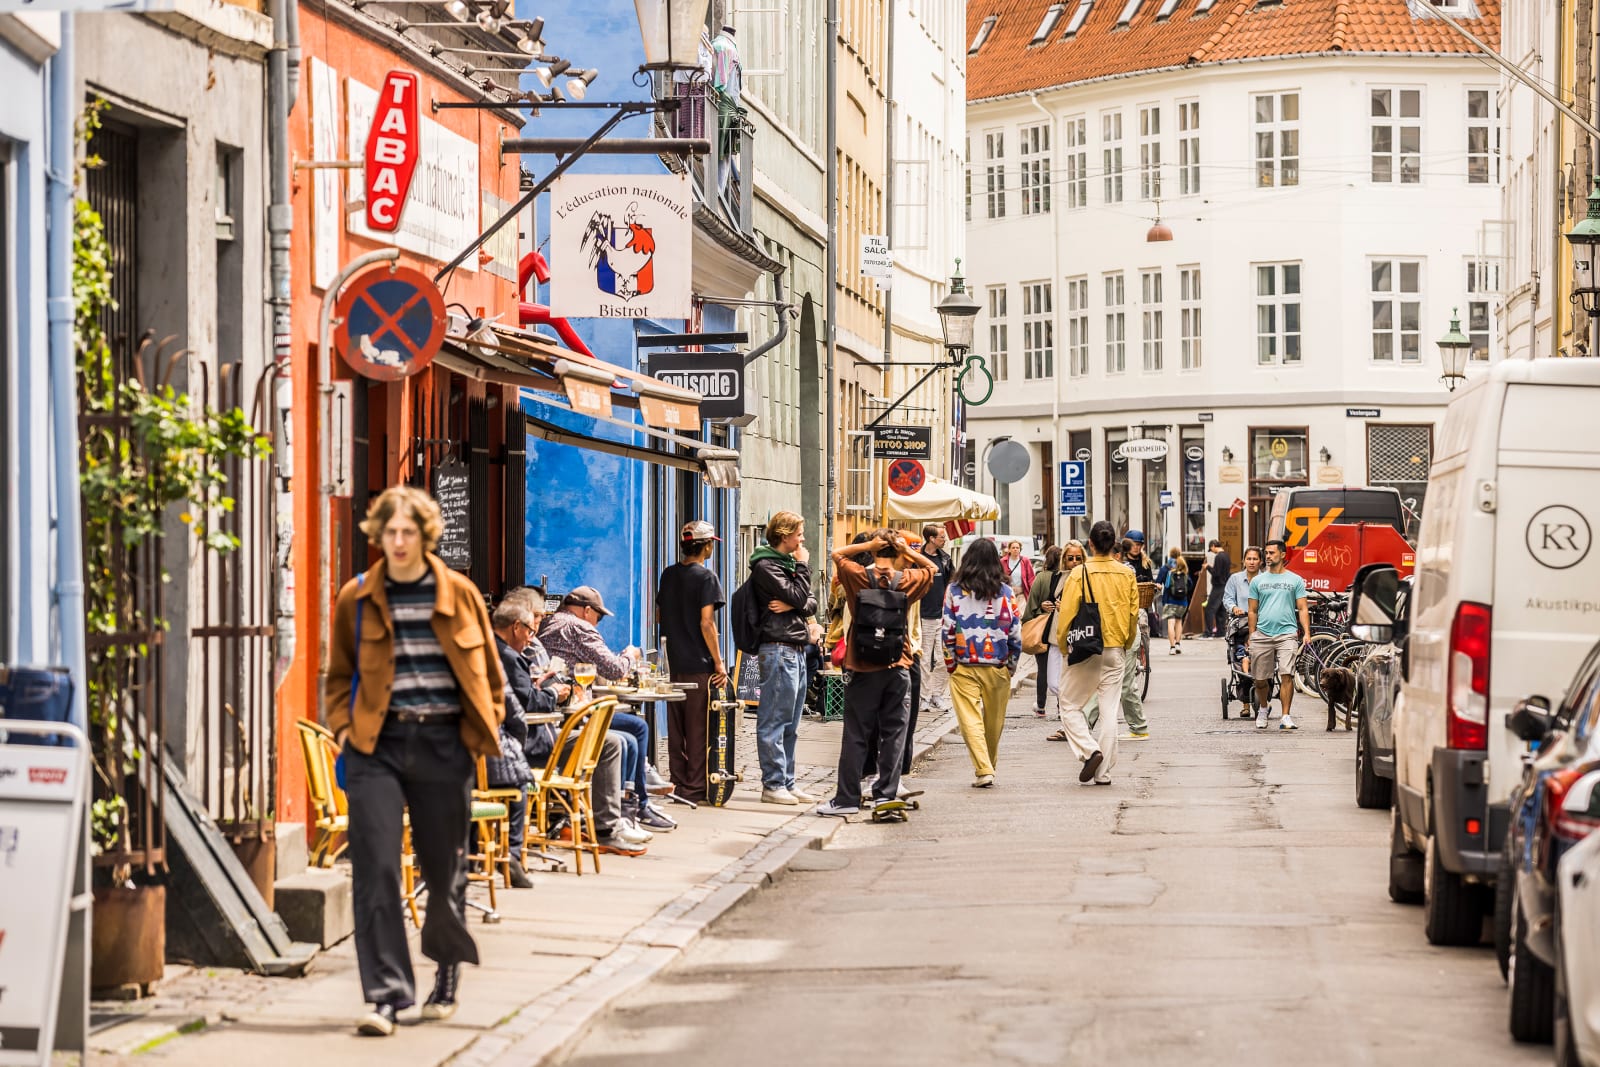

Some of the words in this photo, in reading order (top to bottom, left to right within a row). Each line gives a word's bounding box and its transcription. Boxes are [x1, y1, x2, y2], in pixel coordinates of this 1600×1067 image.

[371, 78, 410, 224] TABAC
[556, 185, 627, 220] L'éducation
[632, 186, 688, 220] nationale
[870, 238, 882, 246] TIL
[599, 304, 649, 317] Bistrot
[874, 440, 902, 449] ATTOO
[903, 441, 927, 450] SHOP
[1066, 463, 1080, 485] P
[1034, 494, 1041, 505] 2
[1541, 523, 1580, 551] KR
